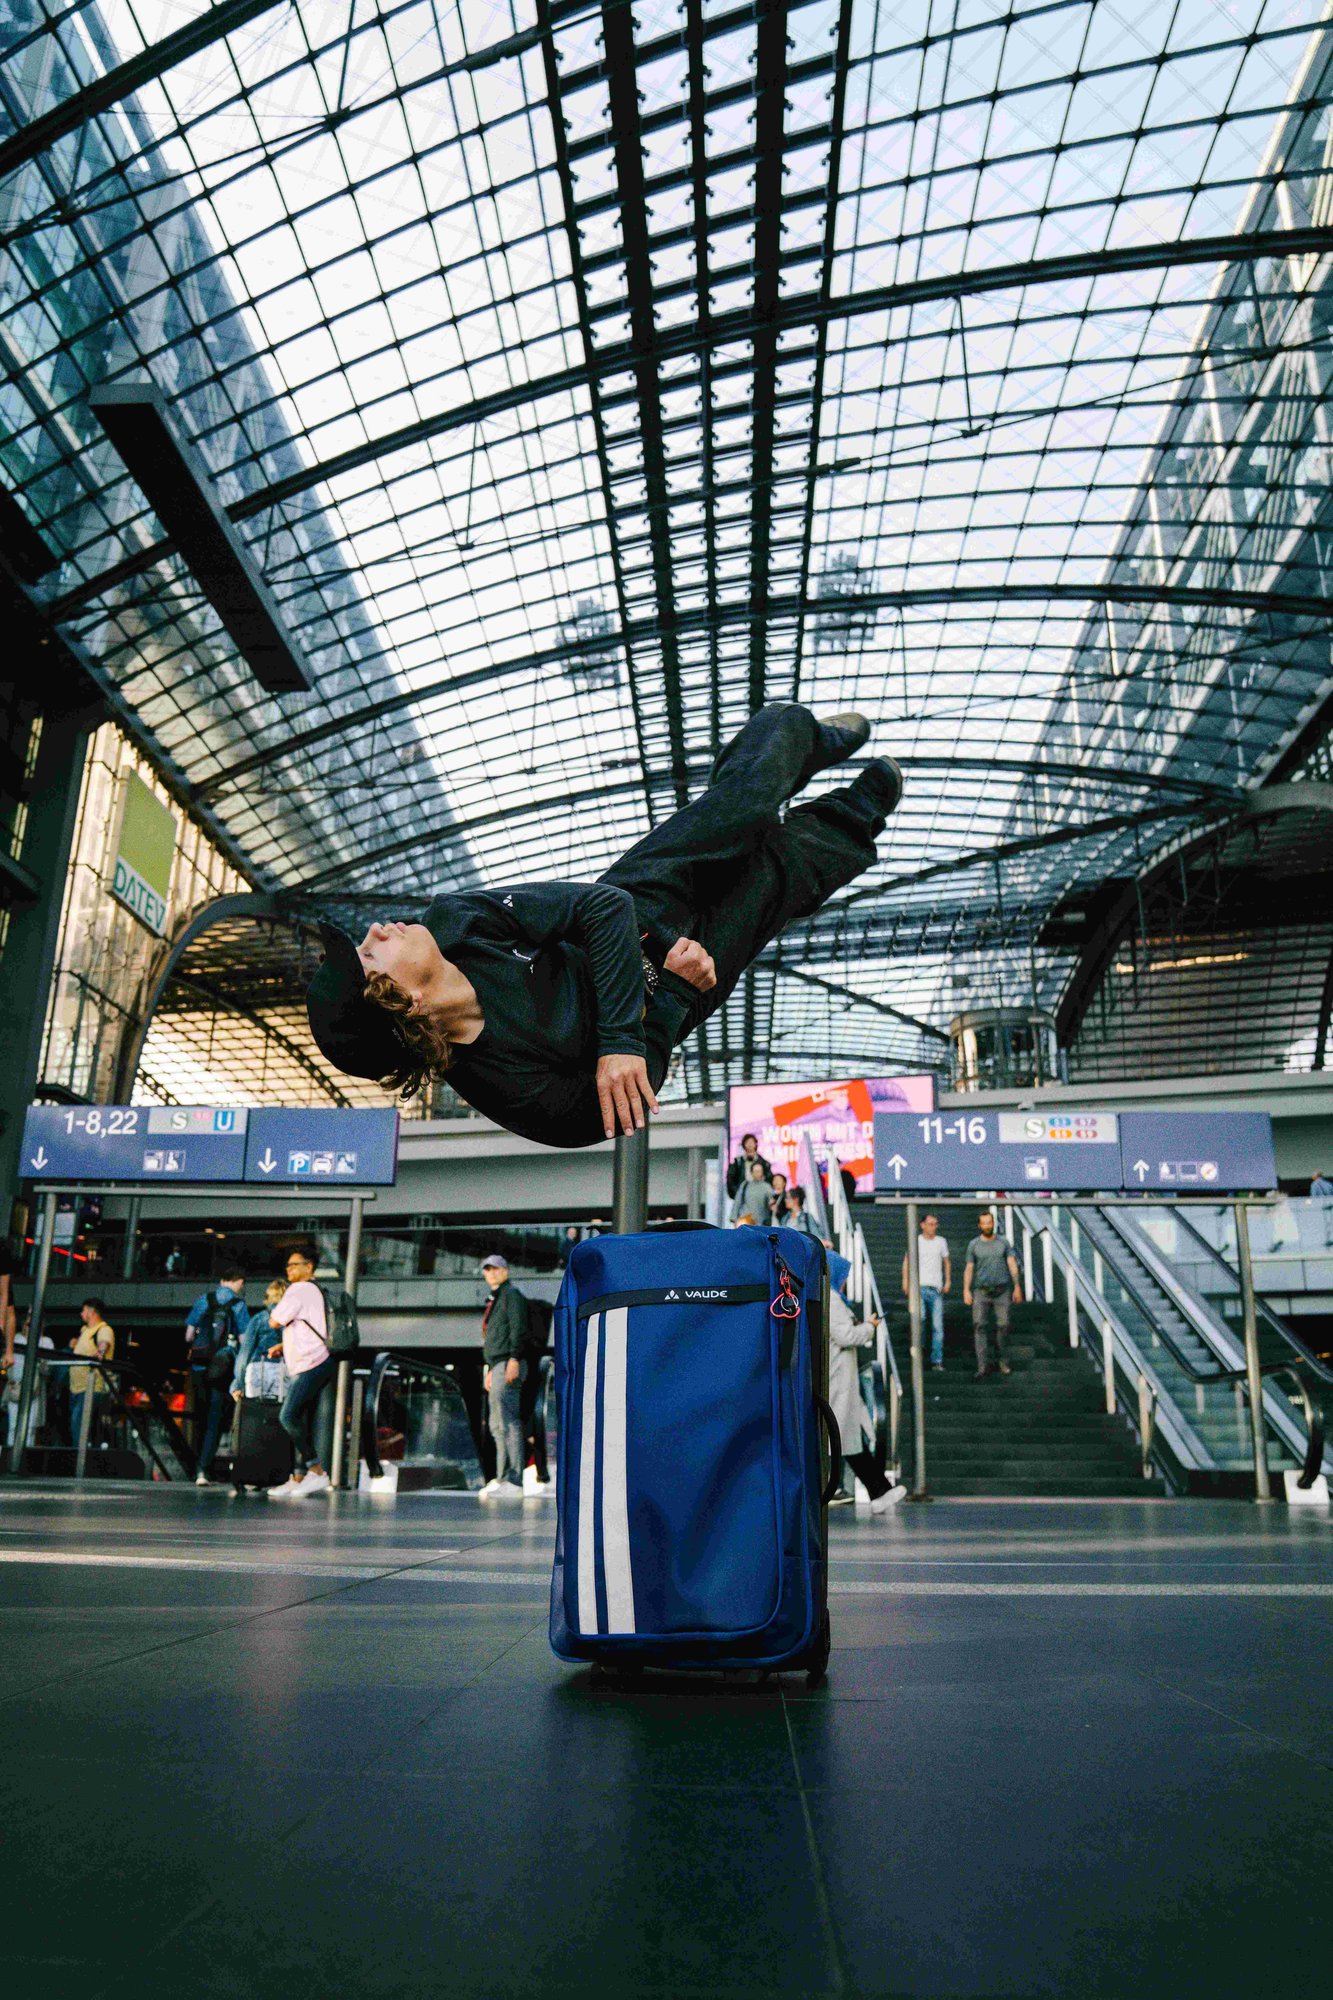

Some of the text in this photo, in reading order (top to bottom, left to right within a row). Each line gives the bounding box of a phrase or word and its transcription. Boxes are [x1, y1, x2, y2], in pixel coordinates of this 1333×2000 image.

[113, 862, 165, 928] DATEV
[64, 1110, 138, 1138] 1-8,22
[171, 1112, 187, 1130] S
[217, 1112, 232, 1131] U
[918, 1116, 987, 1144] 11-16
[1026, 1118, 1045, 1138] S
[685, 1290, 728, 1298] VAUDE
